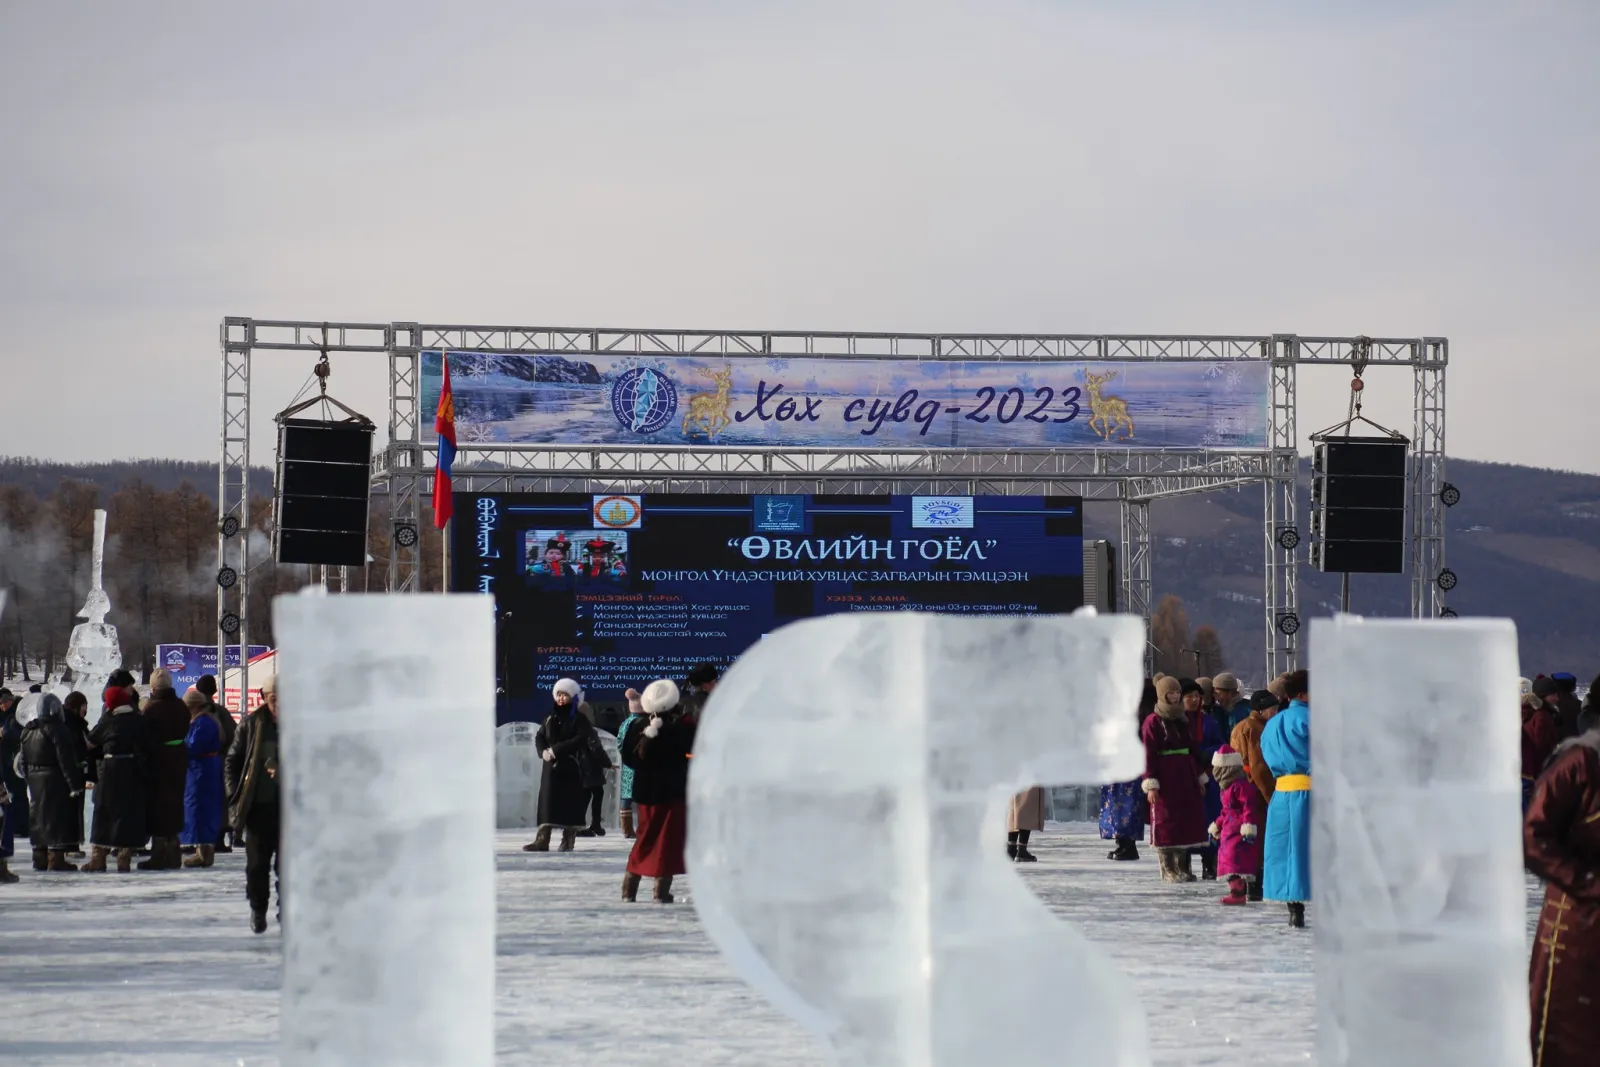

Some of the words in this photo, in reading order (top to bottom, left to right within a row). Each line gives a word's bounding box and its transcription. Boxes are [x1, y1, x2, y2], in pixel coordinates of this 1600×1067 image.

[735, 380, 822, 423] Хөх
[925, 517, 963, 525] TRAVEL
[728, 535, 896, 560] “ӨВЛИЙН
[901, 536, 997, 560] ГОЁЛ”
[641, 570, 710, 581] МОНГОЛ
[712, 569, 806, 583] ҮНДЭСНИЙ
[808, 570, 867, 583] ХУВЦАС
[870, 571, 950, 582] ЗАГВАРЫН
[953, 571, 1029, 584] ТЭМЦЭЭН
[575, 593, 643, 602] ТЭМЦЭЭНИЙ
[636, 603, 688, 612] үндэсний
[691, 603, 712, 611] Хос
[713, 604, 750, 612] хувцас
[850, 603, 895, 611] Тэмцээн
[947, 603, 970, 611] 03-р
[636, 612, 688, 620] үндэсний
[593, 621, 688, 629] /Ганцаарчилсан/
[637, 630, 692, 638] хувцастай
[548, 655, 574, 663] 2023
[600, 655, 616, 663] 3-р
[620, 656, 654, 664] сарын
[657, 655, 681, 663] 2-ны
[683, 655, 722, 663] өдрийн
